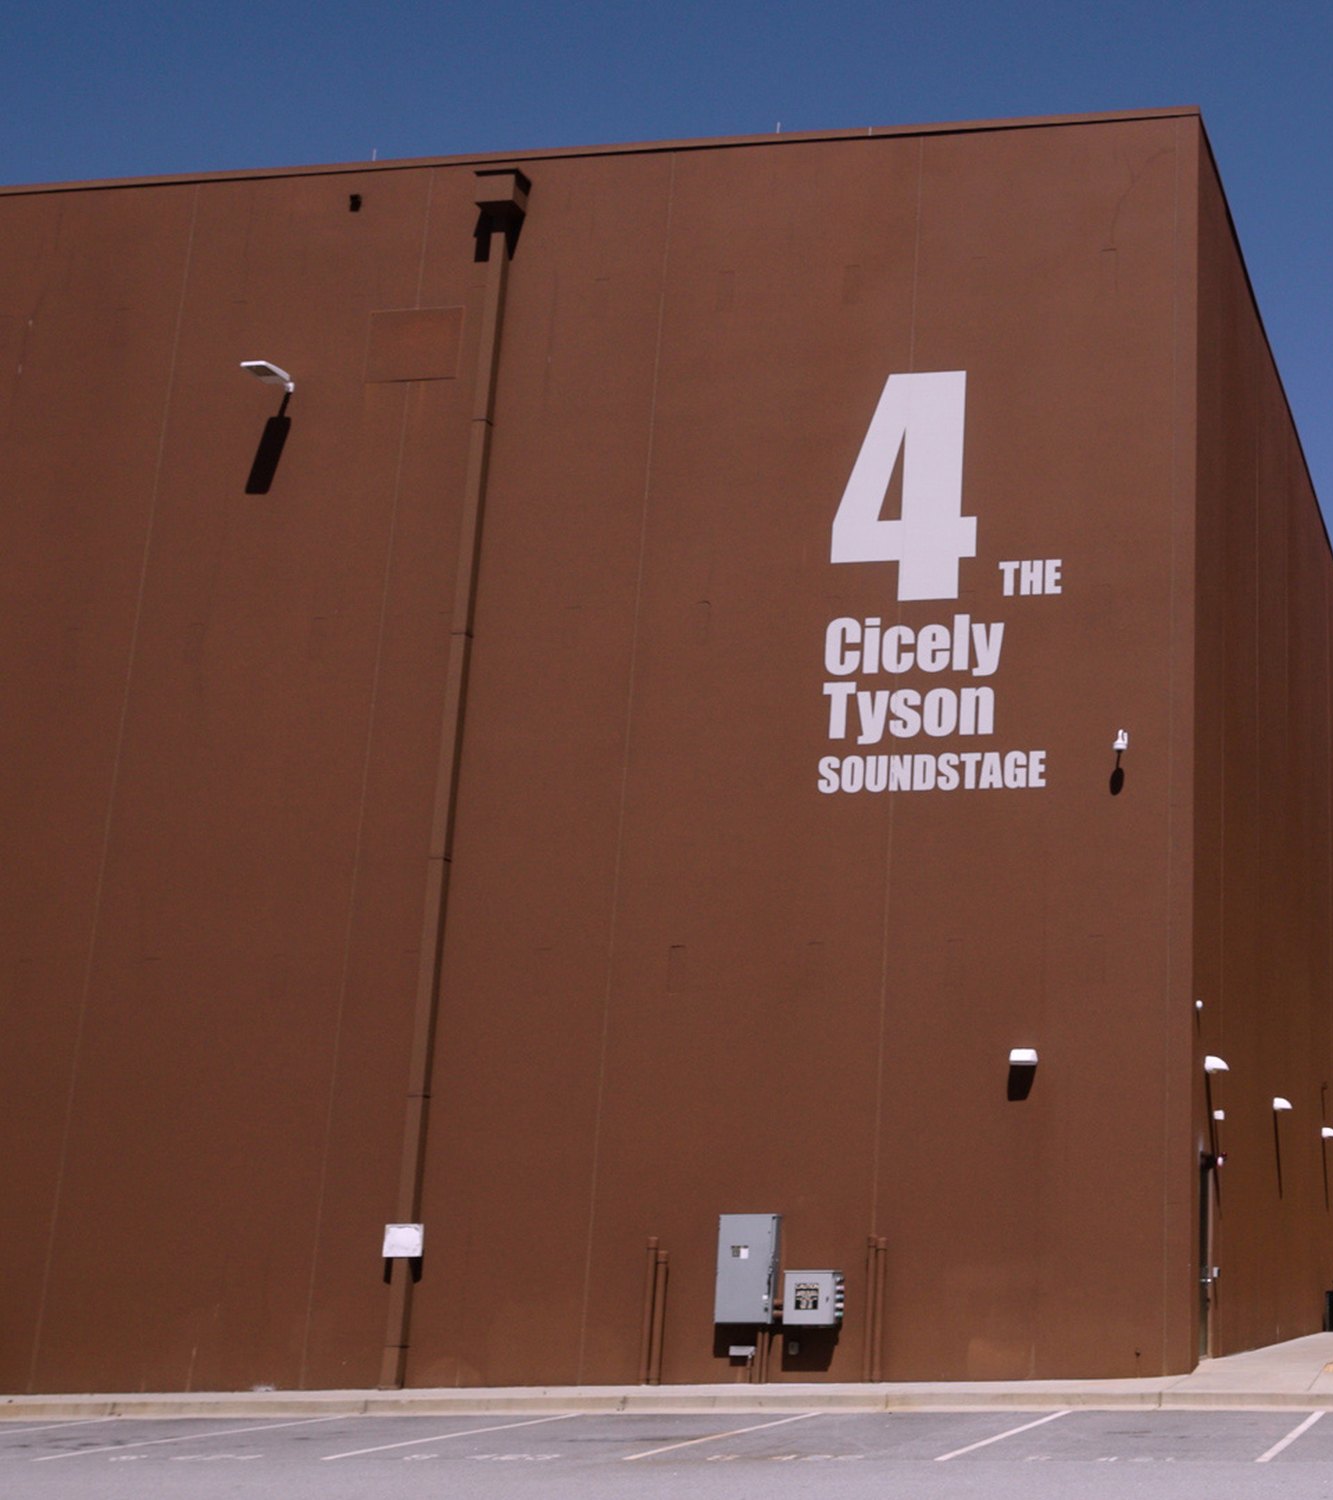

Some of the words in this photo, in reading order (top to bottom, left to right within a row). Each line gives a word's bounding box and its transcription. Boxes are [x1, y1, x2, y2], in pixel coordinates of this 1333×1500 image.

[831, 370, 978, 601] 4
[998, 559, 1062, 597] THE
[824, 614, 1005, 677] Cicely
[823, 681, 995, 745] Tyson
[817, 751, 1047, 794] SOUNDSTAGE
